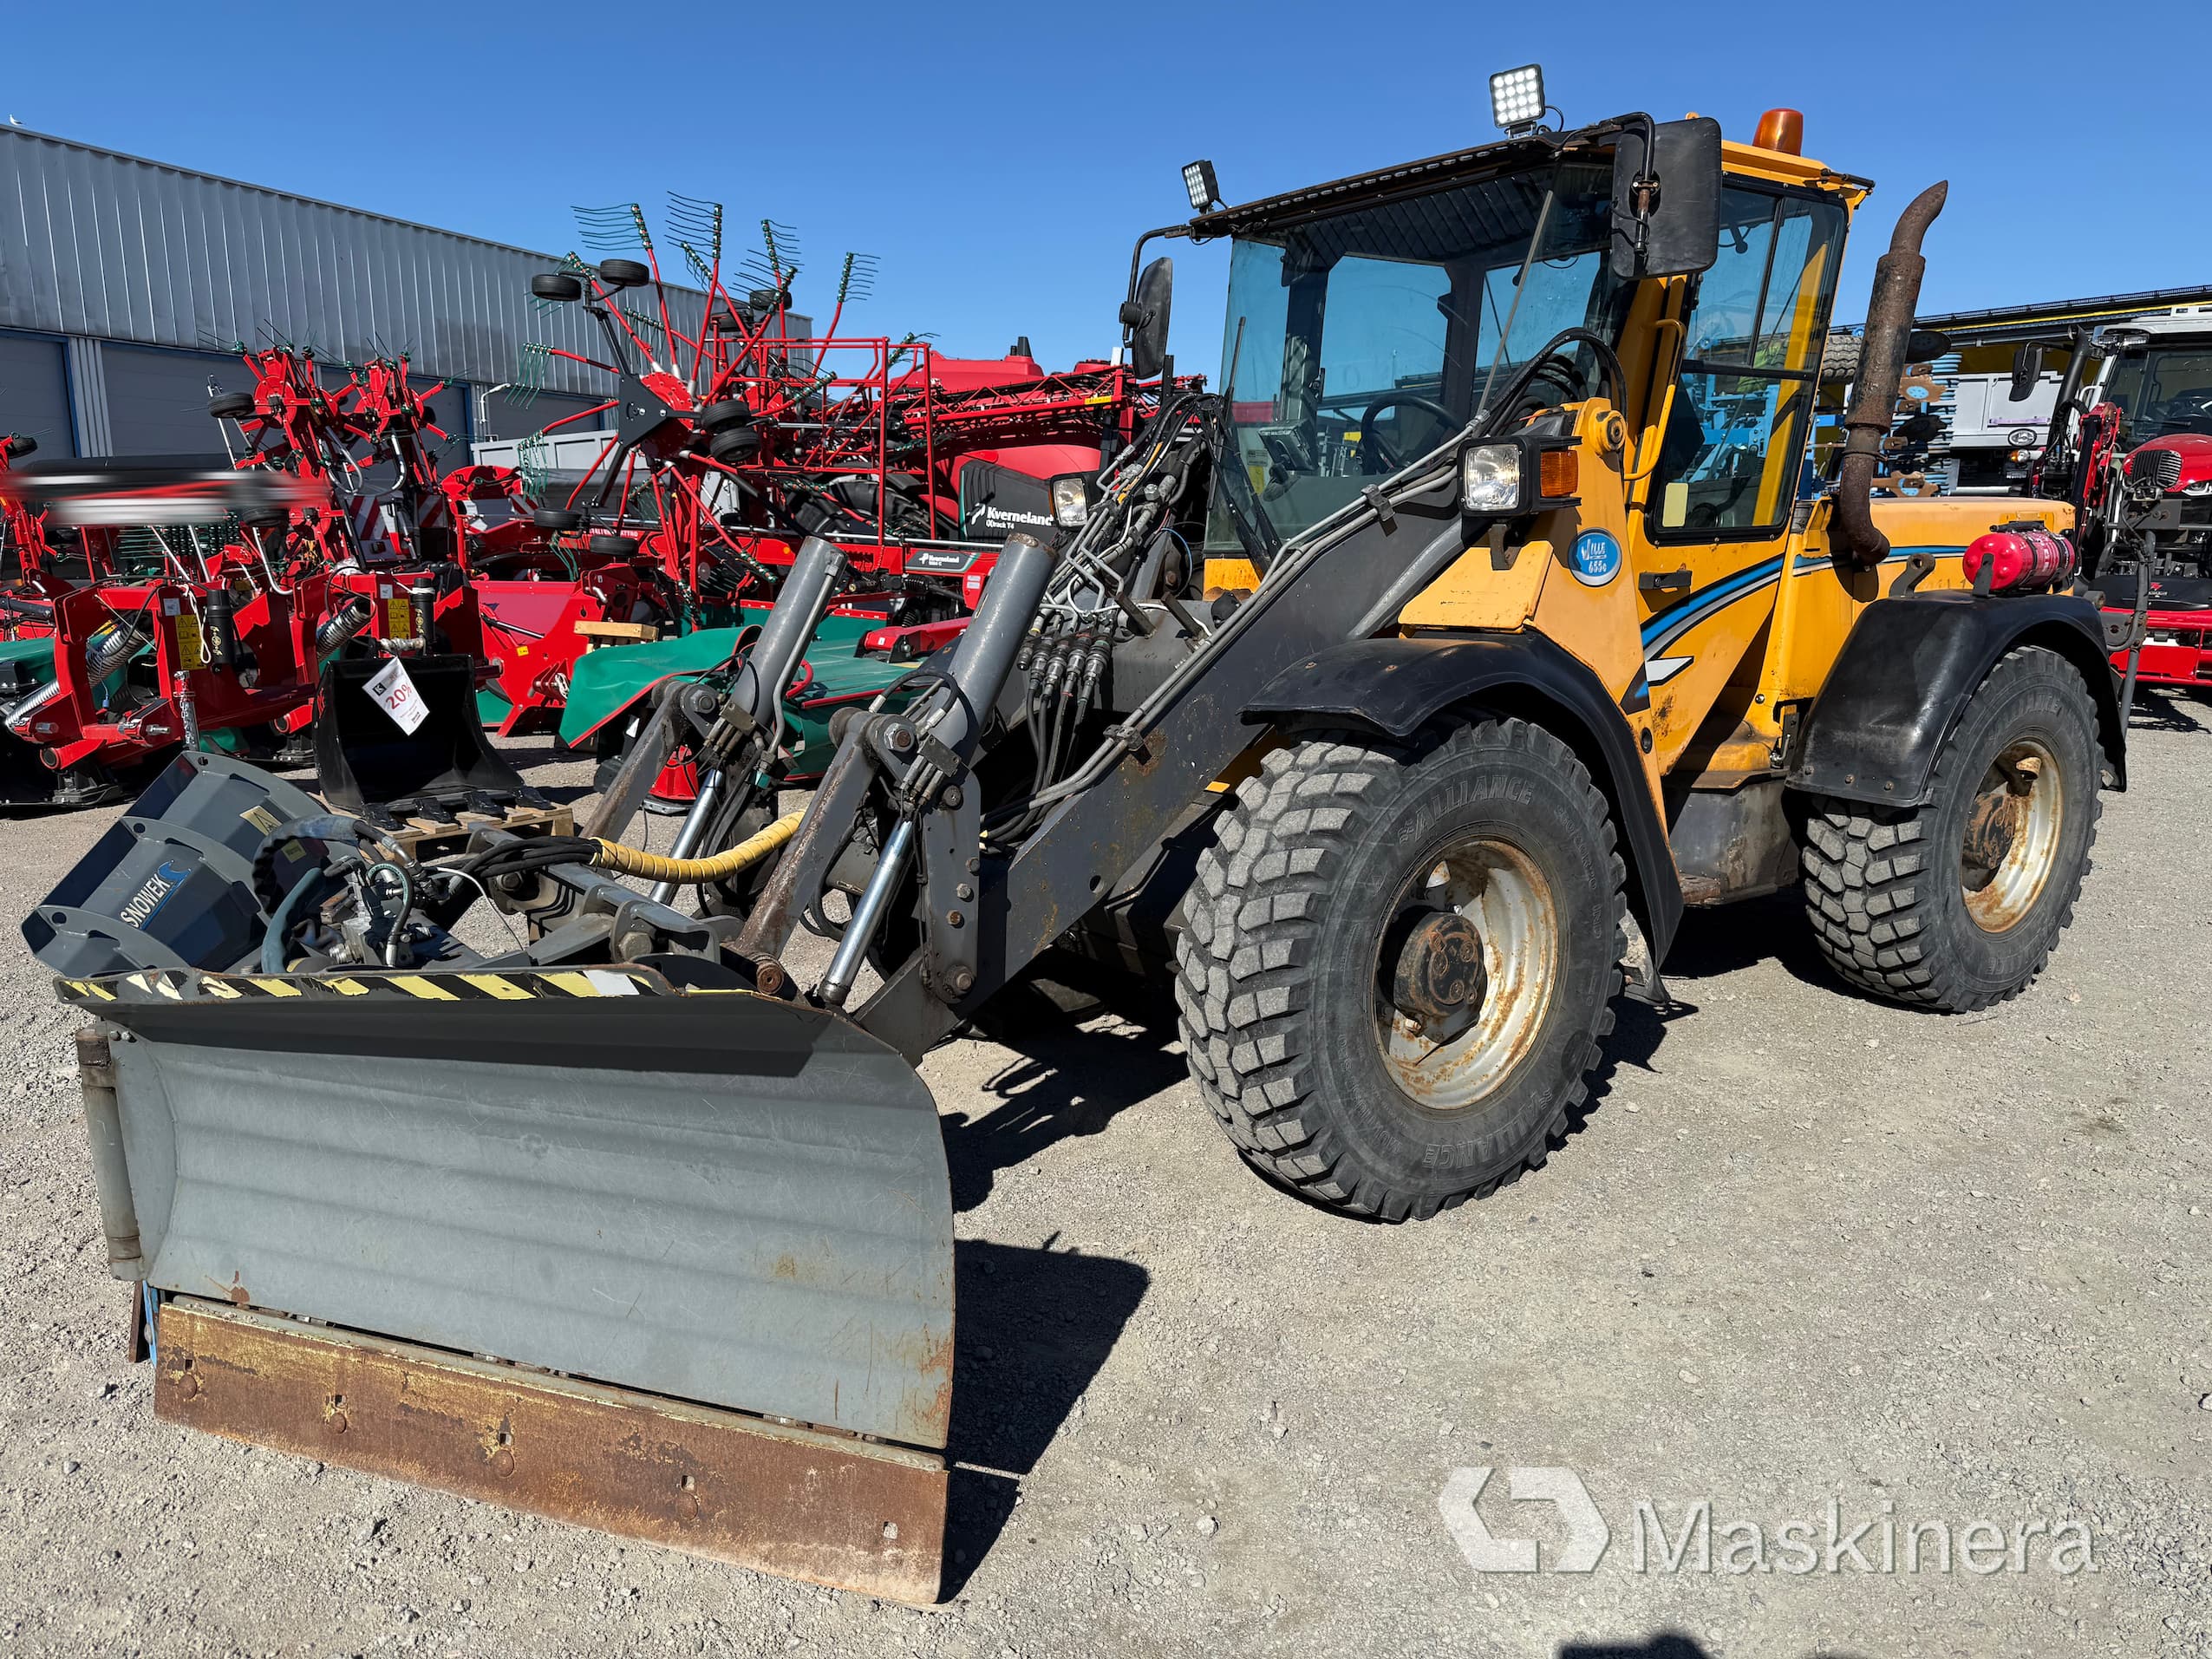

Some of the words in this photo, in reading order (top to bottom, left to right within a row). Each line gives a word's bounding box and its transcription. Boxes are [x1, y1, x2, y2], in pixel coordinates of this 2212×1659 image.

[987, 506, 1054, 526] Kverneland
[385, 682, 413, 709] 20%
[1415, 774, 1536, 842] ALLIANCE
[120, 873, 171, 928] SNOWEK
